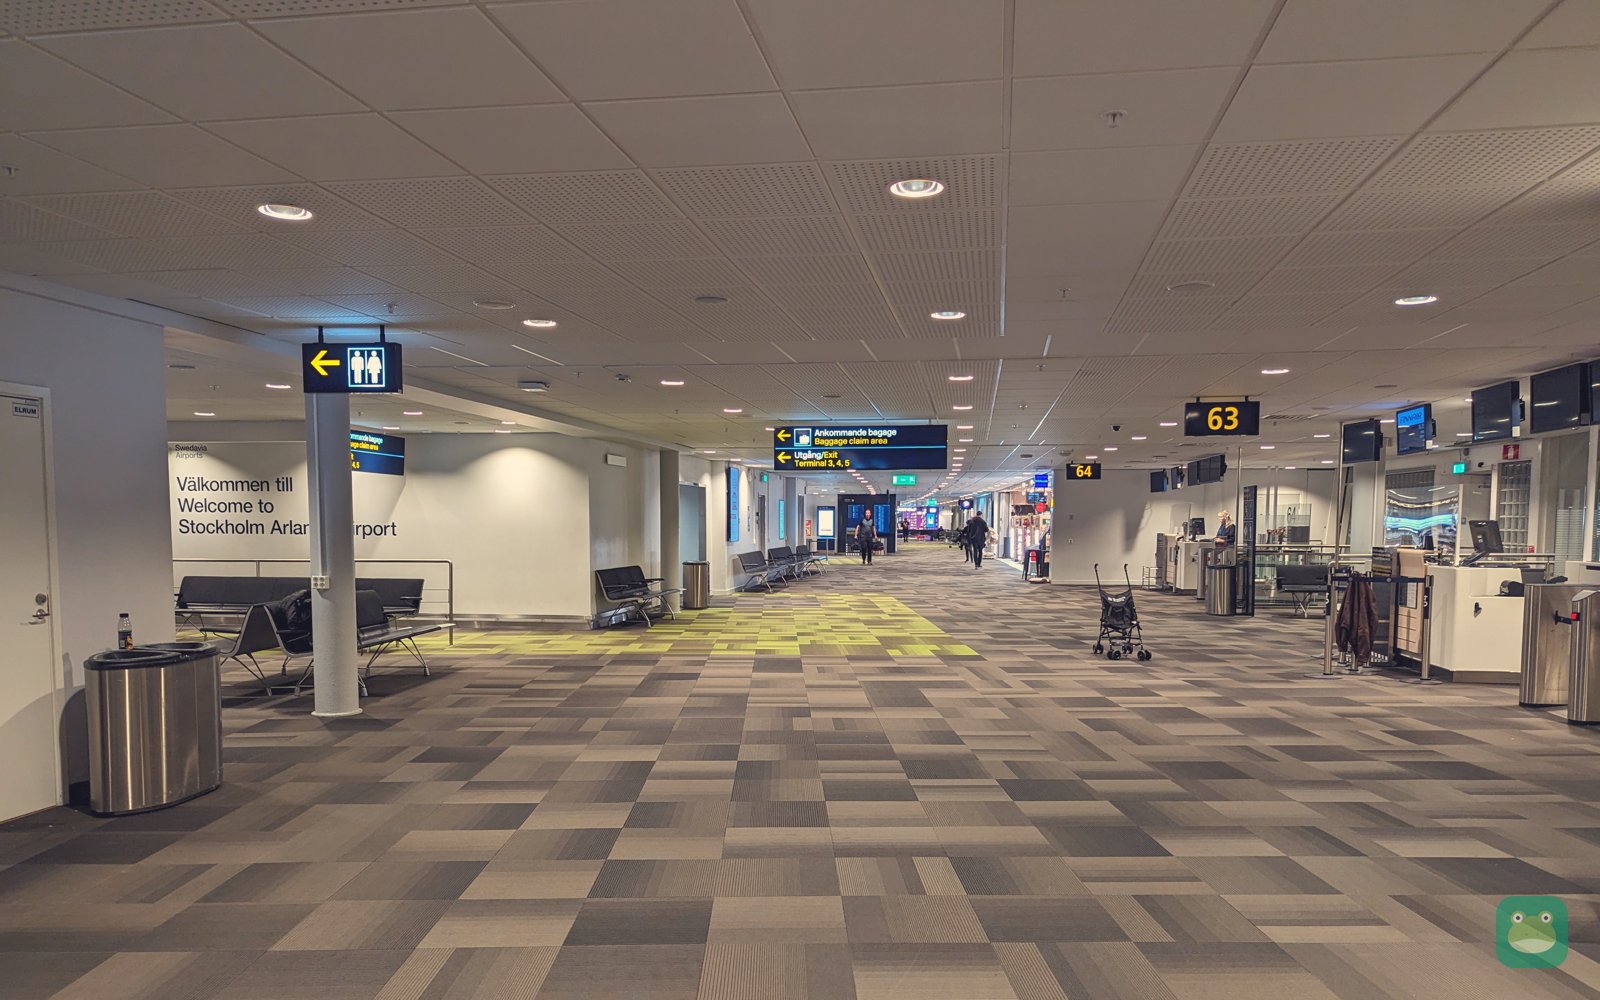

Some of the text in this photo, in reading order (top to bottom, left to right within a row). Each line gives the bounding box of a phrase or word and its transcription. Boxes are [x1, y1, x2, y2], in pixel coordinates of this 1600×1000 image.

[14, 406, 37, 415] ELRUM
[1207, 406, 1239, 431] 63
[814, 428, 897, 438] Ankommande bagage
[814, 437, 848, 446] Baggage
[849, 437, 868, 445] claim
[175, 444, 208, 452] Swedavia
[175, 452, 204, 460] Airports
[794, 459, 827, 467] Terminal
[828, 460, 836, 468] 3,
[836, 460, 844, 468] 4,
[1076, 465, 1092, 478] 64
[176, 476, 293, 492] Välkommen till
[177, 497, 274, 514] Welcome to
[178, 518, 265, 535] Stockholm
